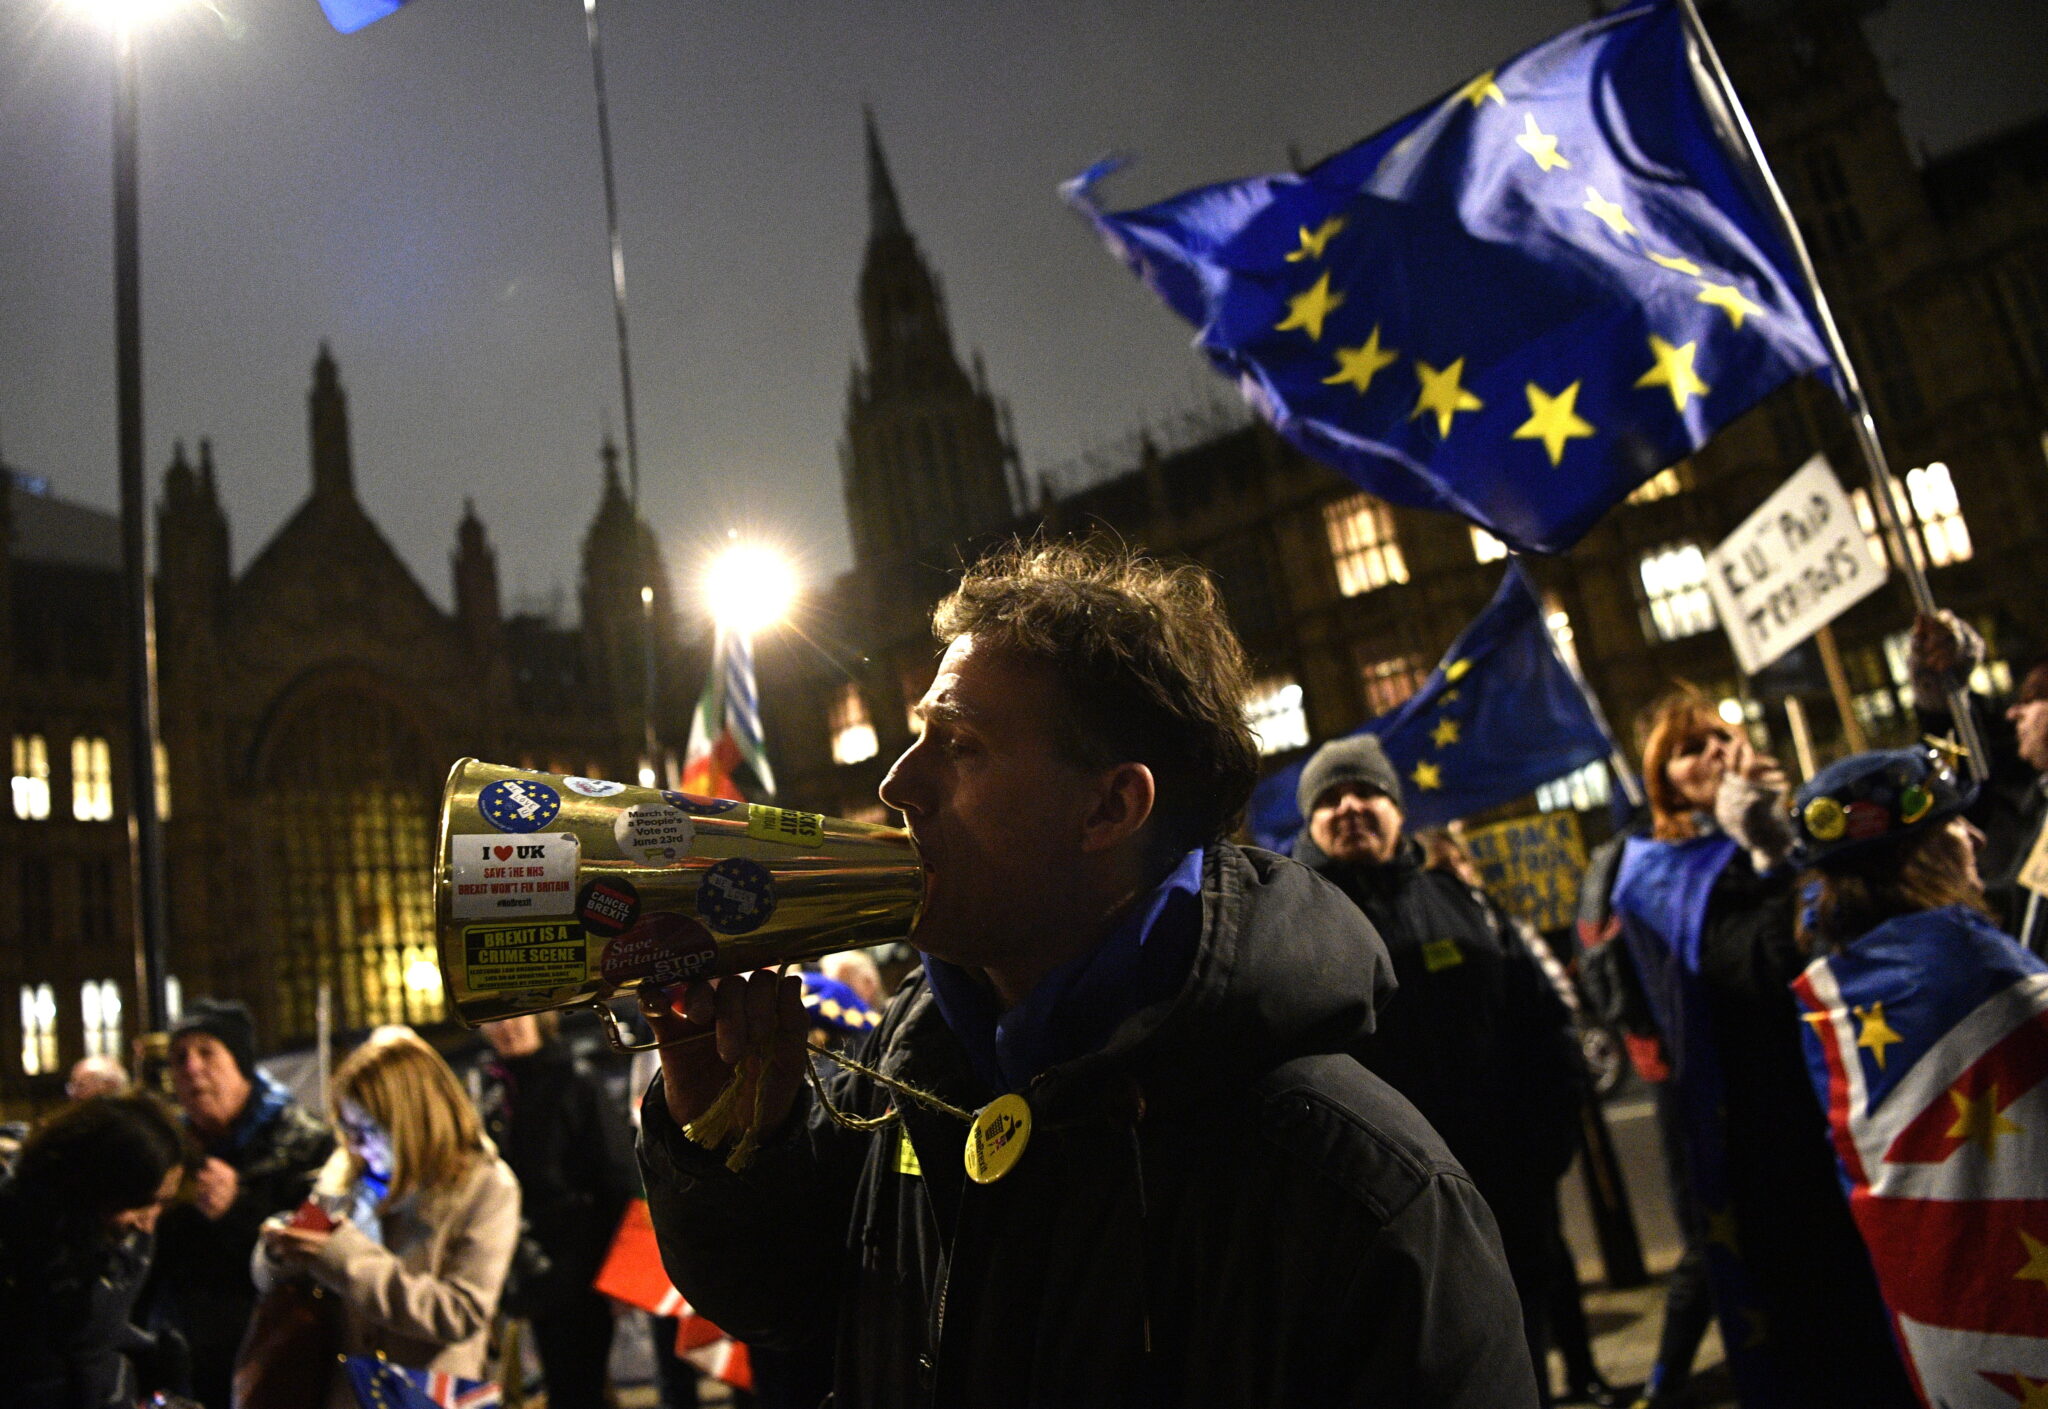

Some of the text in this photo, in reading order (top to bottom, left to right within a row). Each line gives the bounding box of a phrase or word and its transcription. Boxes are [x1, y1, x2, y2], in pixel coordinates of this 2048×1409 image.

[628, 810, 662, 818] March
[637, 818, 683, 827] People's
[636, 826, 677, 836] Vote on
[633, 834, 684, 847] June 23rd
[482, 845, 545, 860] I UK
[484, 866, 544, 878] SAVE THE NHS
[458, 881, 570, 895] BREXIT WON'T FIX BRITAIN
[591, 891, 631, 914] CANCEL
[586, 901, 629, 923] BREXIT
[484, 926, 568, 948] BREXIT IS A
[611, 938, 652, 957] Save
[478, 948, 575, 964] CRIME SCENE
[655, 950, 715, 973] STOP
